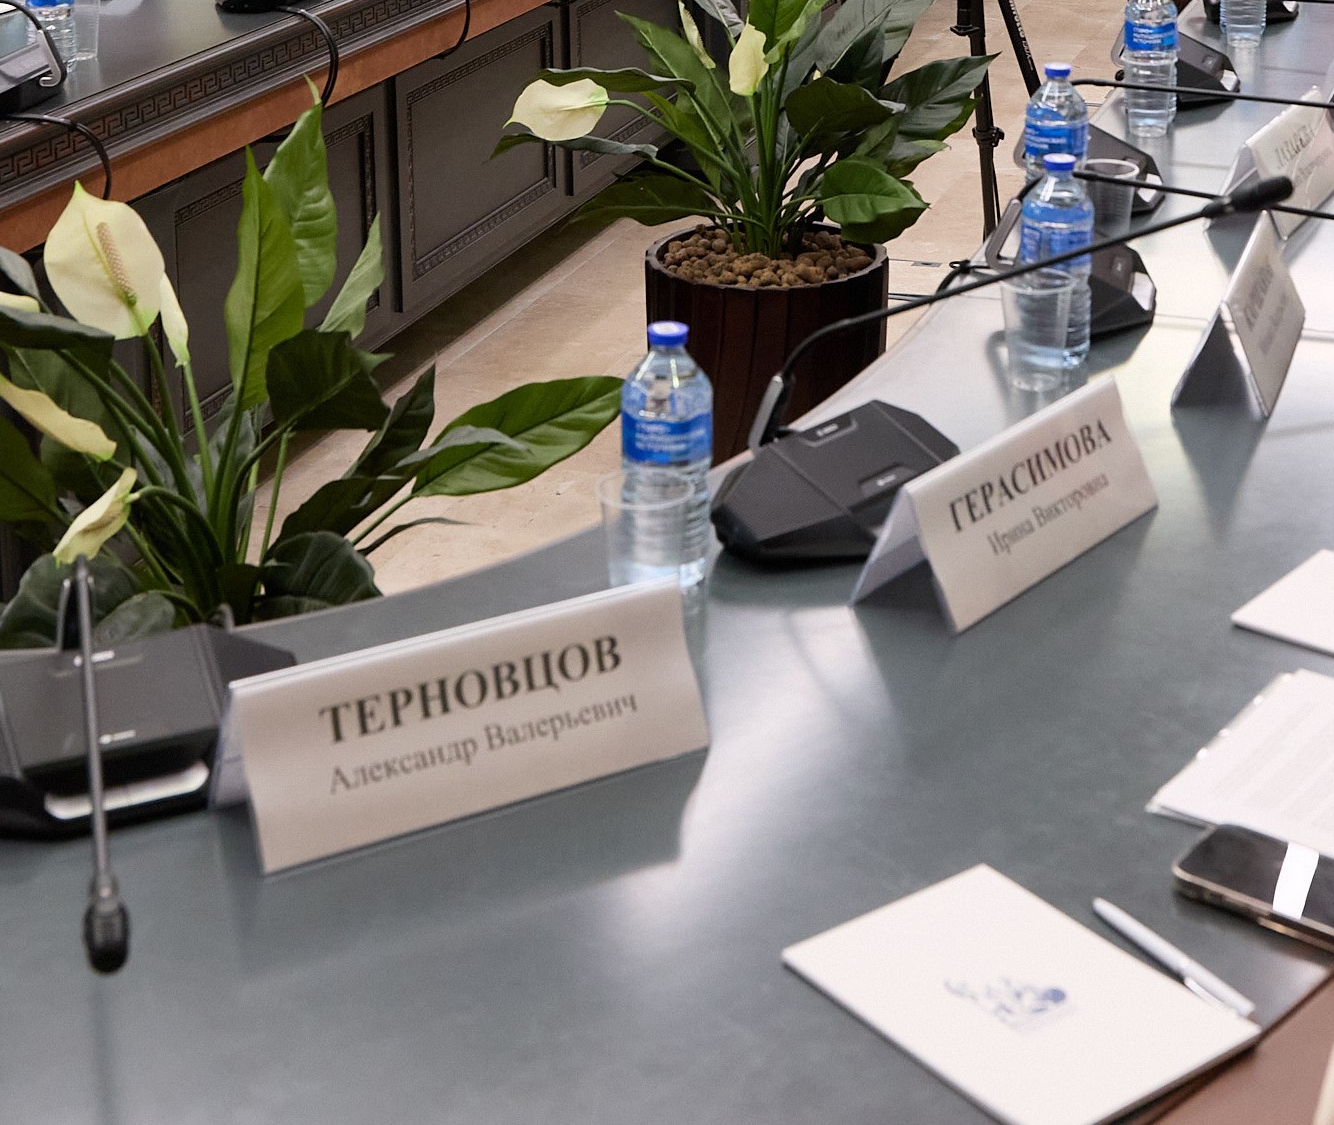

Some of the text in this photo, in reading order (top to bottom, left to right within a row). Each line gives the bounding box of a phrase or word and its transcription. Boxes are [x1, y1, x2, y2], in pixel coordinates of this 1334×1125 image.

[949, 419, 1113, 534] ГЕРАСИМОВА
[1032, 473, 1110, 529] Викторовна
[319, 635, 624, 745] ТЕРНОВЦОВ
[328, 690, 638, 795] Александр Валерьевич
